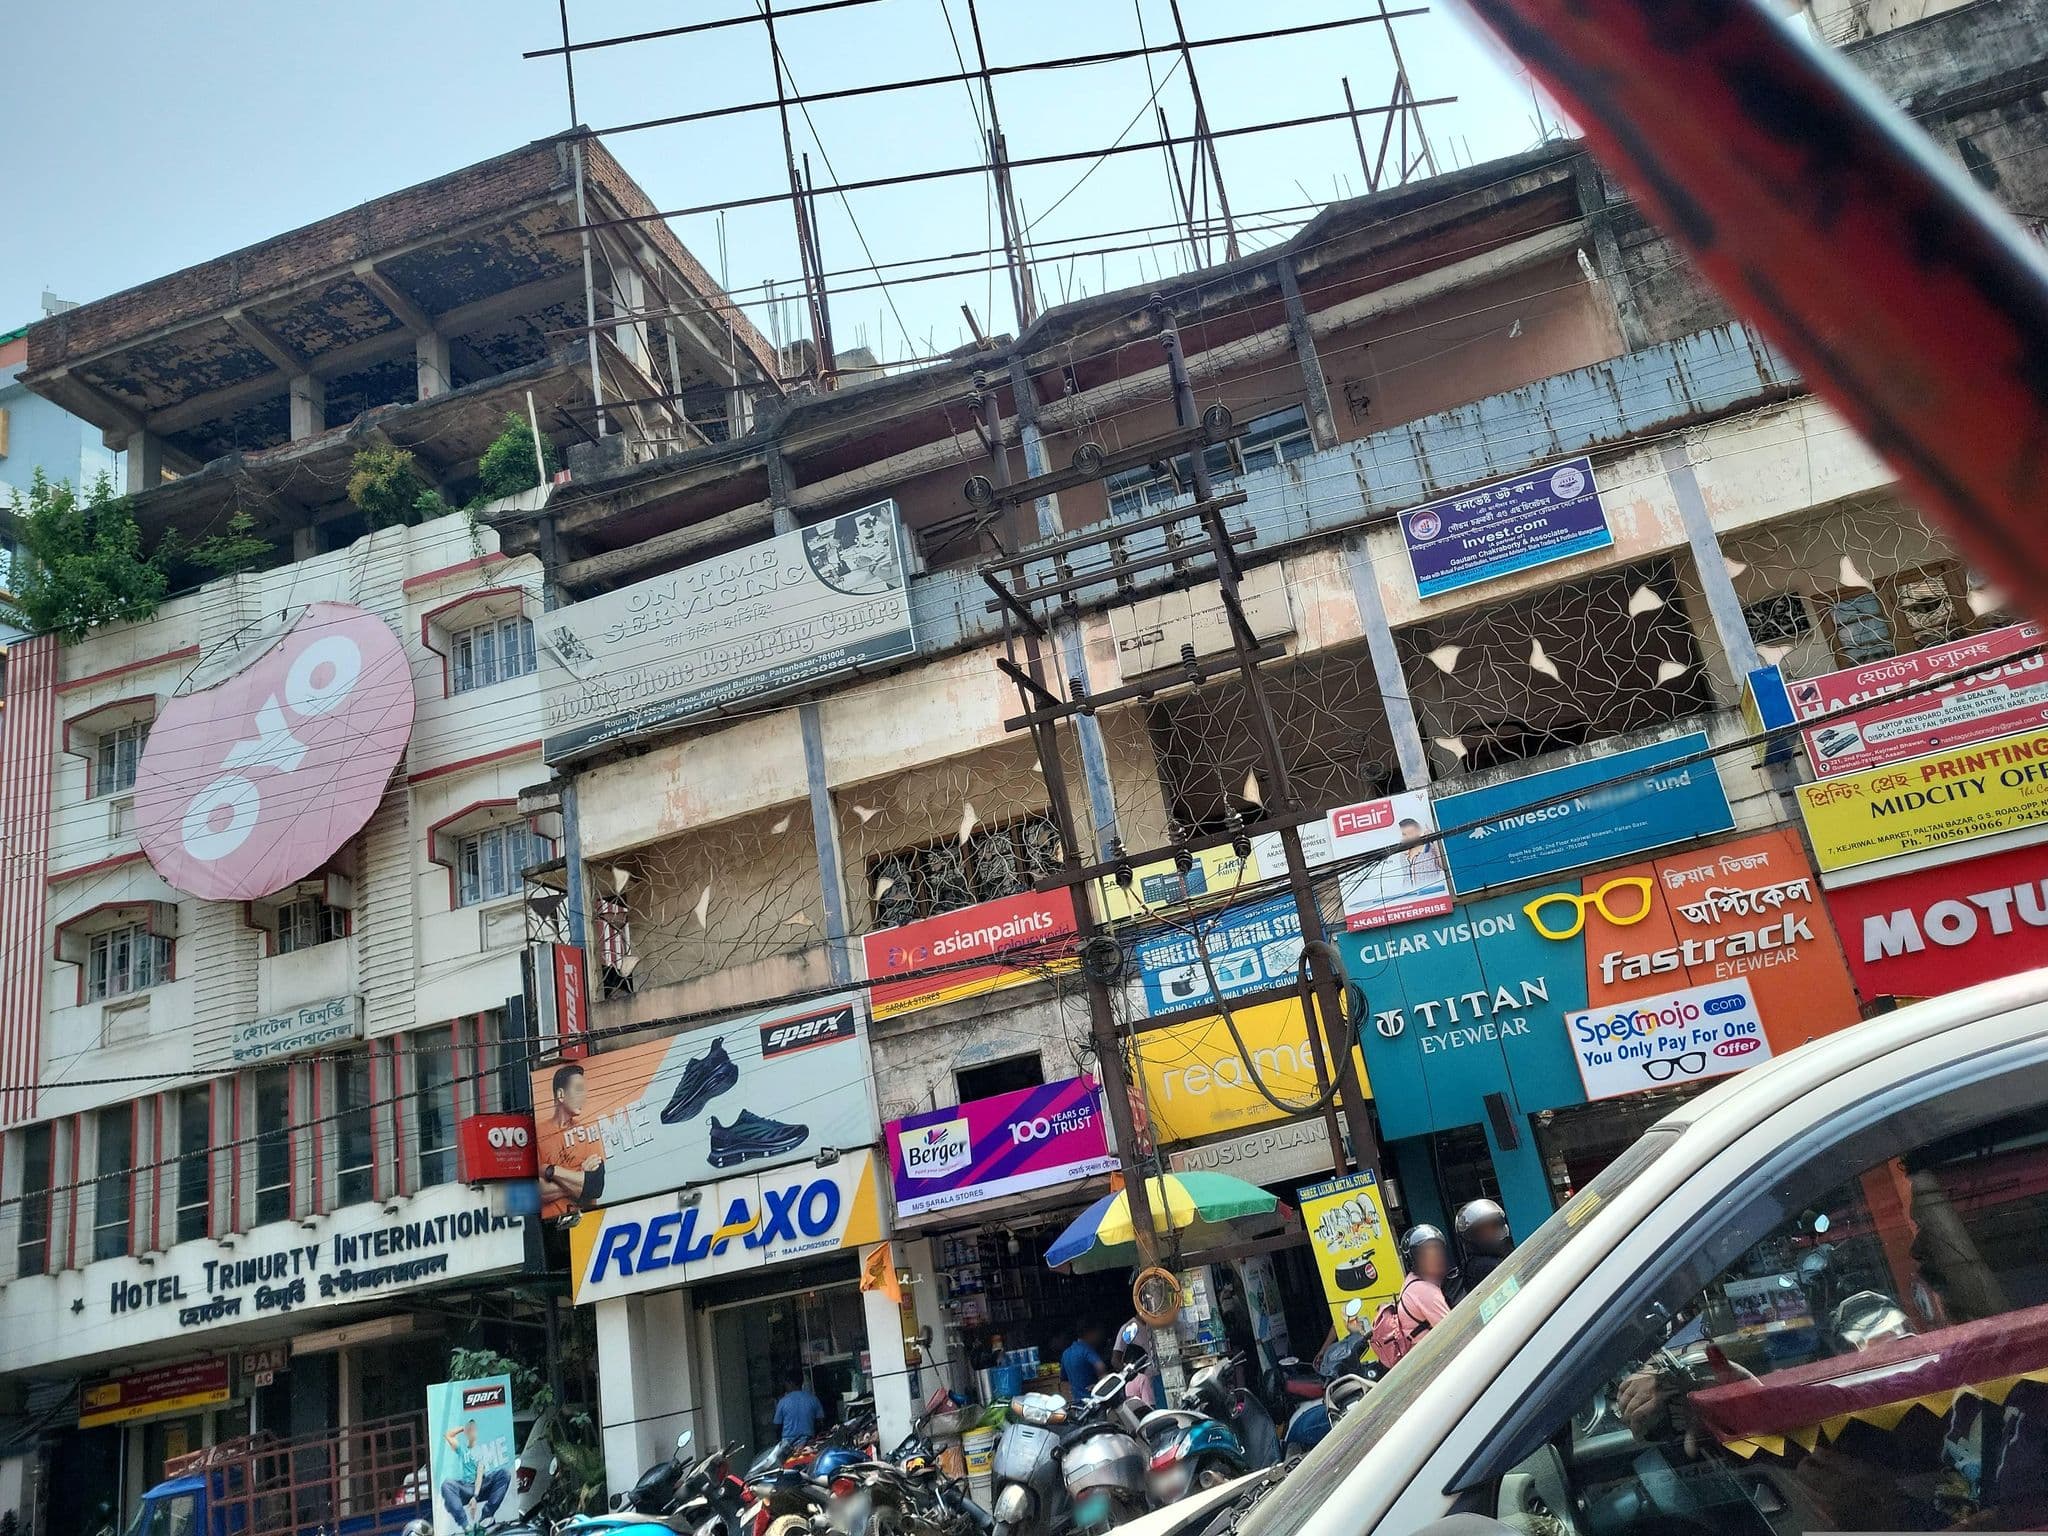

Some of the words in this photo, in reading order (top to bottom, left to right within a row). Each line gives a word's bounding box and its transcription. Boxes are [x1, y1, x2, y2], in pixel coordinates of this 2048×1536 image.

[1450, 553, 1478, 566] Gautam
[1479, 540, 1521, 558] Chakraborty
[1529, 527, 1569, 544] Associates
[1462, 518, 1549, 550] Invest.com
[624, 580, 678, 613] ON
[686, 549, 779, 593] TIME
[603, 564, 806, 644] SERVICING
[549, 678, 619, 728] Mobile
[623, 660, 695, 702] Phone
[698, 622, 815, 678] Repairing
[817, 598, 900, 641] Centre
[604, 713, 629, 730] Room
[700, 682, 731, 702] Kejriwal
[1868, 730, 1896, 742] DISPLAY
[1897, 725, 1922, 736] CABLE,
[1922, 720, 1939, 730] FAN,
[1940, 711, 1977, 725] SPEAKERS,
[1978, 704, 2005, 717] HINGES,
[2007, 699, 2029, 710] BASE,
[2029, 695, 2040, 704] DC
[1877, 719, 1903, 732] LAPTOP
[1904, 710, 1943, 725] KEYBOARD,
[1944, 703, 1975, 715] SCREEN,
[1976, 694, 2009, 708] BATTERY,
[588, 718, 645, 744] Contact
[181, 634, 362, 862] OYO
[1855, 751, 1875, 762] Floor,
[1885, 750, 1907, 759] Assam
[1920, 737, 2048, 783] PRINTING
[1871, 776, 1985, 819] MIDCITY
[2019, 786, 2035, 800] The
[1337, 808, 1388, 833] Flair
[1500, 803, 1570, 833] Invesco
[1836, 837, 1876, 852] KEJRIWAL
[1877, 829, 1914, 844] MARKET,
[1914, 821, 1945, 836] PALTAN
[1945, 815, 1977, 828] BAZAR,
[1901, 837, 1922, 849] Ph.
[1925, 818, 2003, 843] 7005619066
[1556, 839, 1570, 848] Floor
[1719, 852, 1769, 876] ভিজন
[1353, 915, 1386, 929] AKASH
[1387, 903, 1448, 922] ENTERPRISE
[1863, 879, 2048, 963] MOTU
[933, 910, 1055, 957] asianpaints
[1142, 942, 1187, 972] SHREE
[1228, 919, 1274, 951] METAL
[1360, 933, 1431, 964] CLEAR
[1433, 913, 1516, 947] VISION
[1598, 912, 1815, 986] fastrack
[1715, 947, 1800, 979] EYEWEAR
[914, 991, 942, 1007] STORES
[1413, 976, 1550, 1029] TITAN
[242, 1016, 294, 1041] হোটেল
[767, 1010, 848, 1049] sparx
[1420, 1018, 1531, 1054] EYEWEAR
[1583, 1051, 1613, 1067] You
[1618, 1041, 1653, 1060] Only
[1658, 1035, 1687, 1052] Pay
[1692, 1028, 1718, 1045] For
[1724, 1021, 1757, 1038] One
[1717, 1040, 1757, 1056] Offer
[1162, 1038, 1328, 1102] reame
[1007, 1116, 1050, 1145] 100
[1051, 1109, 1077, 1123] YEARS
[1078, 1105, 1091, 1117] OF
[1051, 1114, 1092, 1136] TRUST
[488, 1126, 528, 1150] OYO
[563, 1125, 586, 1149] IT'S
[1182, 1138, 1260, 1174] MUSIC
[1262, 1117, 1350, 1155] PLANT
[909, 1141, 968, 1168] Berger
[1334, 1176, 1353, 1194] METAL
[1353, 1171, 1372, 1187] STORE
[912, 1202, 925, 1211] M/S
[925, 1195, 954, 1208] SARALA
[955, 1188, 984, 1201] STORES
[589, 1177, 842, 1284] RELAXO
[110, 1274, 188, 1315] HOTEL
[202, 1243, 321, 1295] TRIMURTY
[178, 1294, 243, 1327] হোটেল
[465, 1387, 502, 1406] sparx
